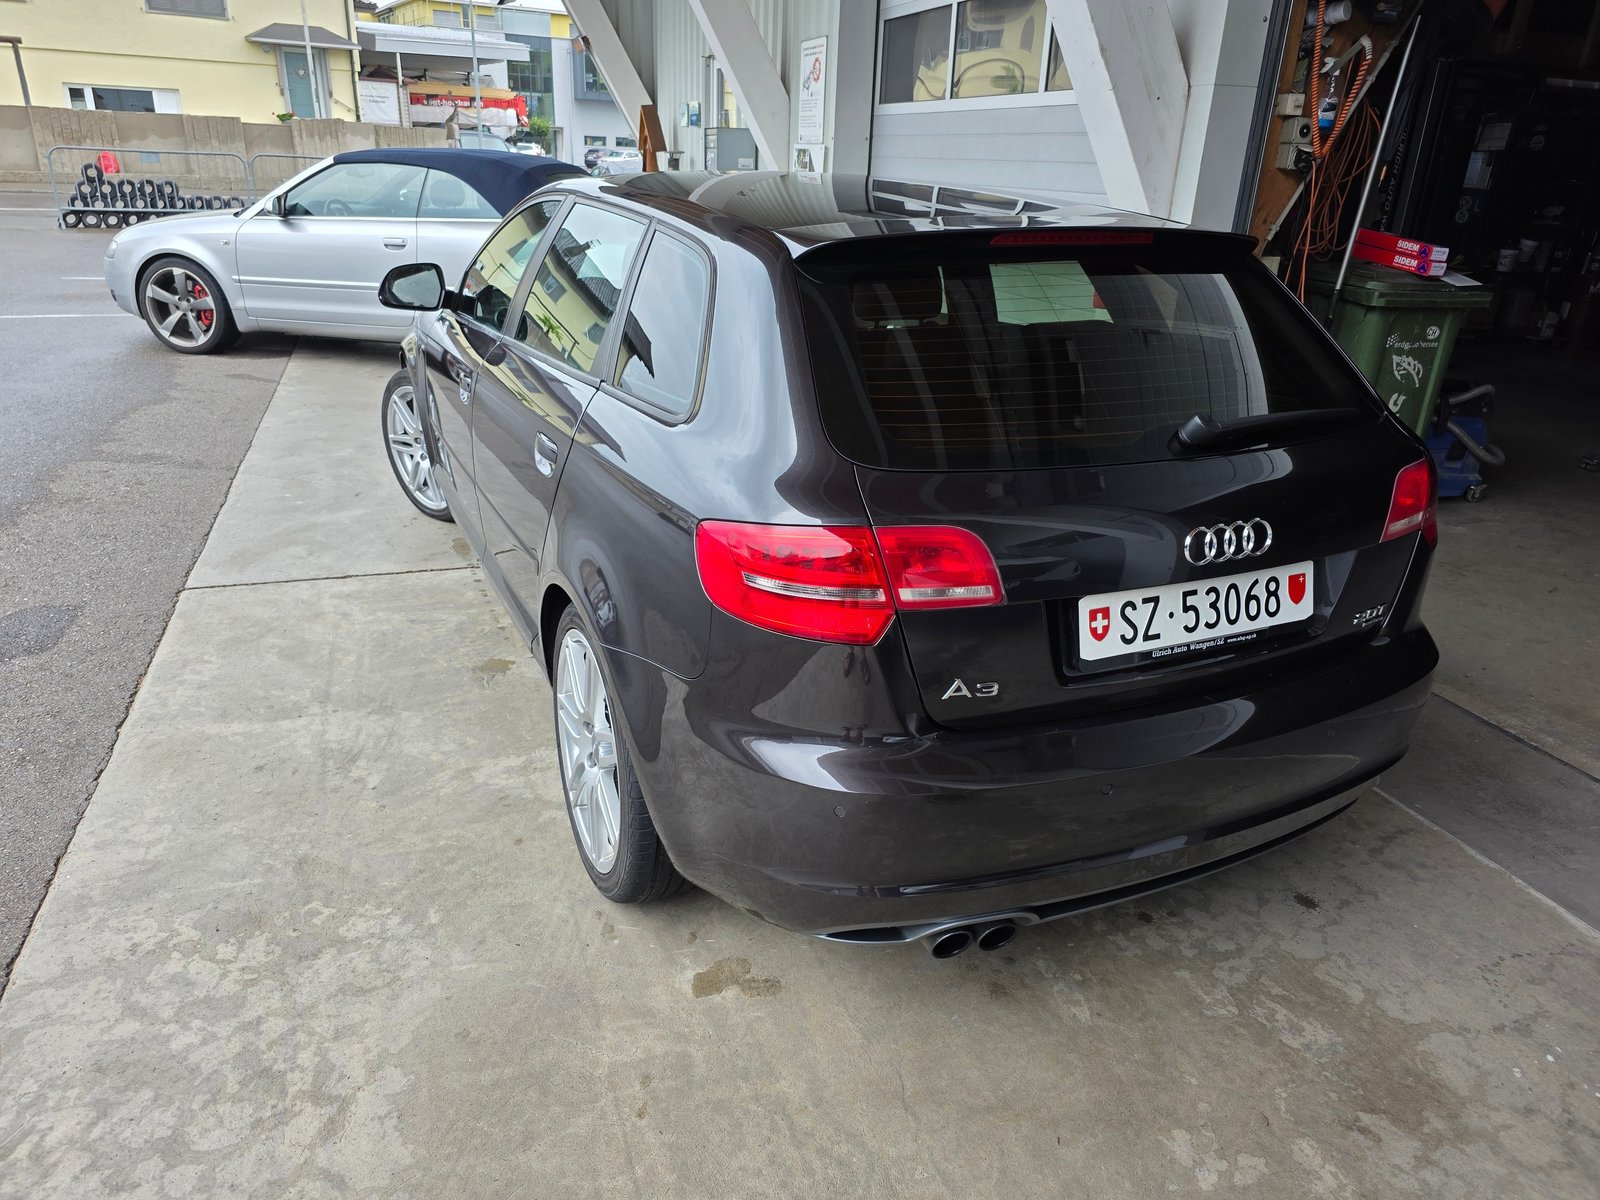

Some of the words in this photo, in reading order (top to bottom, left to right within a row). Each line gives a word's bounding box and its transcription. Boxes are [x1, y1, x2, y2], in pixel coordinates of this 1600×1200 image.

[1397, 240, 1420, 251] SIDEM
[1394, 255, 1418, 267] SIDEM
[1152, 647, 1172, 658] Ulrich
[1172, 645, 1188, 654] Auto
[1189, 637, 1225, 651] Wangen/SZ
